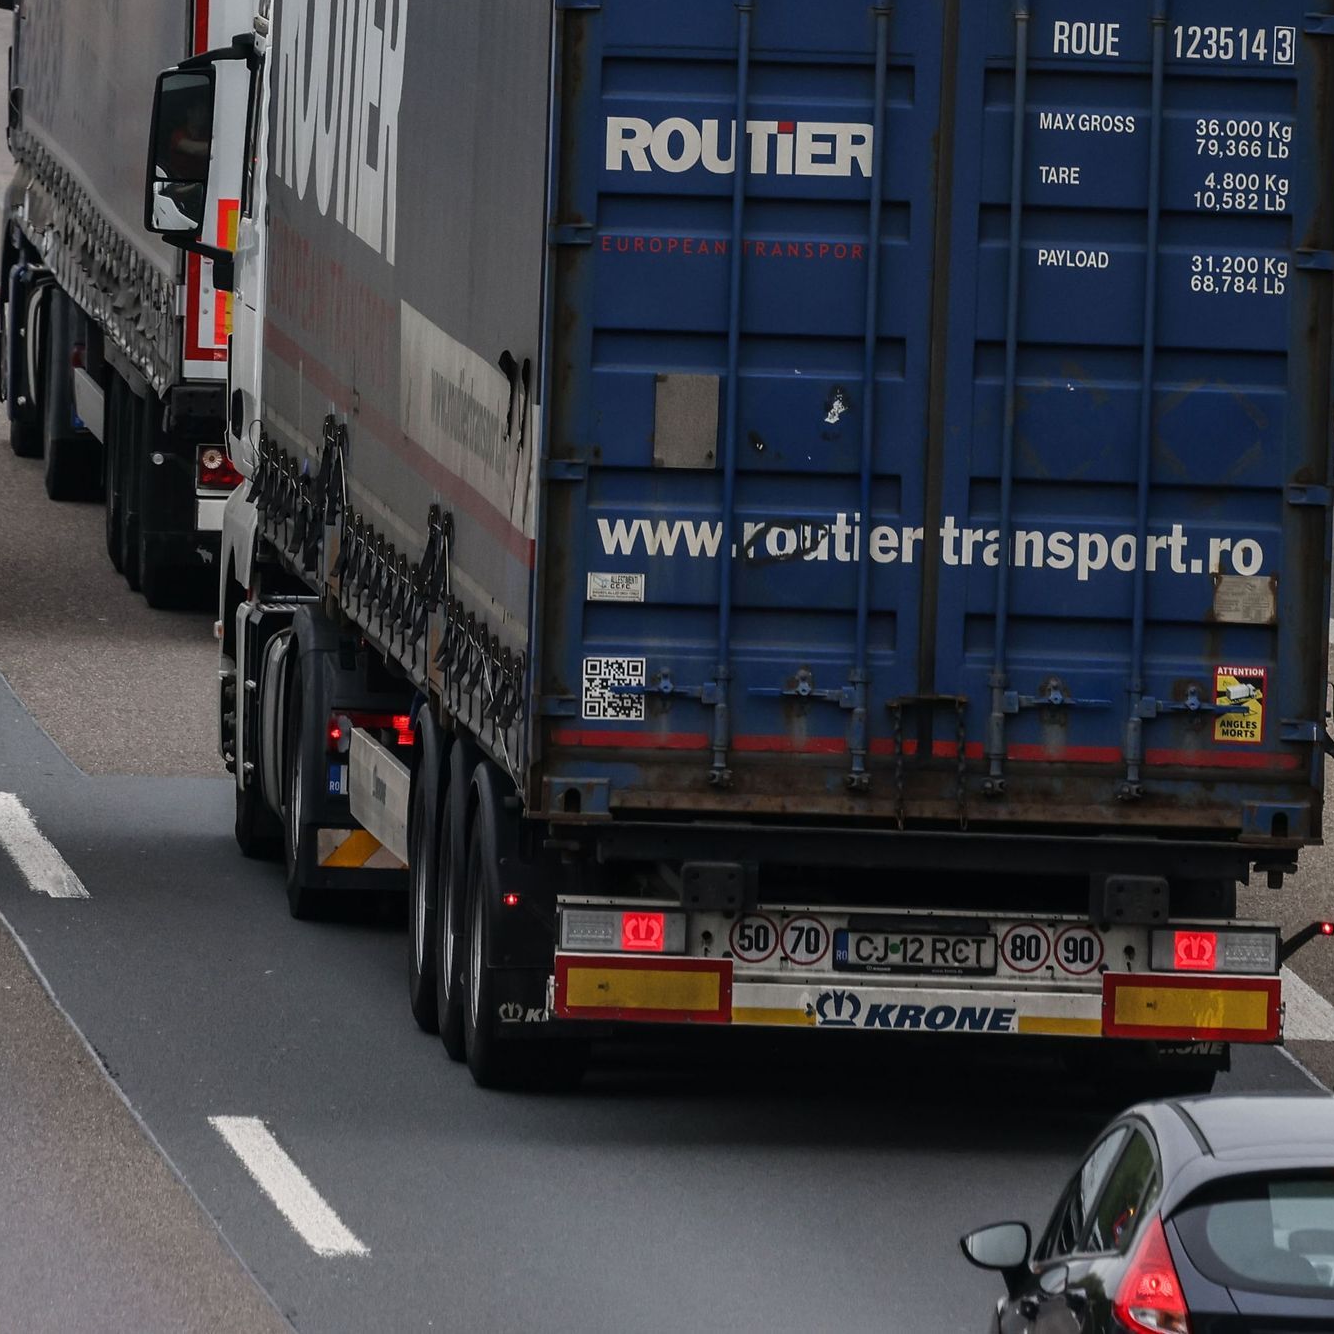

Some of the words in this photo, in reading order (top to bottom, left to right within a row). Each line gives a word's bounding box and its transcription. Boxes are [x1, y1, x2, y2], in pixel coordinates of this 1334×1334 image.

[1053, 21, 1120, 56] ROUE
[1174, 25, 1267, 61] 123514
[1039, 112, 1075, 131] MAX
[1079, 115, 1135, 133] GROSS
[1196, 119, 1263, 138] 36.000
[1269, 121, 1292, 142] Kg
[1196, 139, 1262, 158] 79,366
[1267, 140, 1289, 159] Lb
[1039, 166, 1080, 185] TARE
[1205, 172, 1259, 190] 4.800
[1265, 174, 1289, 195] Kg
[1194, 192, 1258, 211] 10,582
[1264, 193, 1286, 211] Lb
[602, 236, 727, 254] EUROPEAN
[1038, 250, 1109, 268] PAYLOAD
[1191, 255, 1259, 274] 31.200
[1264, 258, 1288, 278] Kg
[1190, 275, 1258, 294] 68,784
[1263, 277, 1285, 294] Lb
[1217, 666, 1264, 676] ATTENTION
[1220, 720, 1257, 729] ANGLES
[1221, 729, 1255, 738] MORTS
[739, 923, 769, 953] 50
[789, 926, 820, 955] 70
[1010, 933, 1041, 962] 80
[1063, 936, 1095, 964] 90
[835, 949, 848, 962] RO
[864, 1003, 1016, 1032] KRONE
